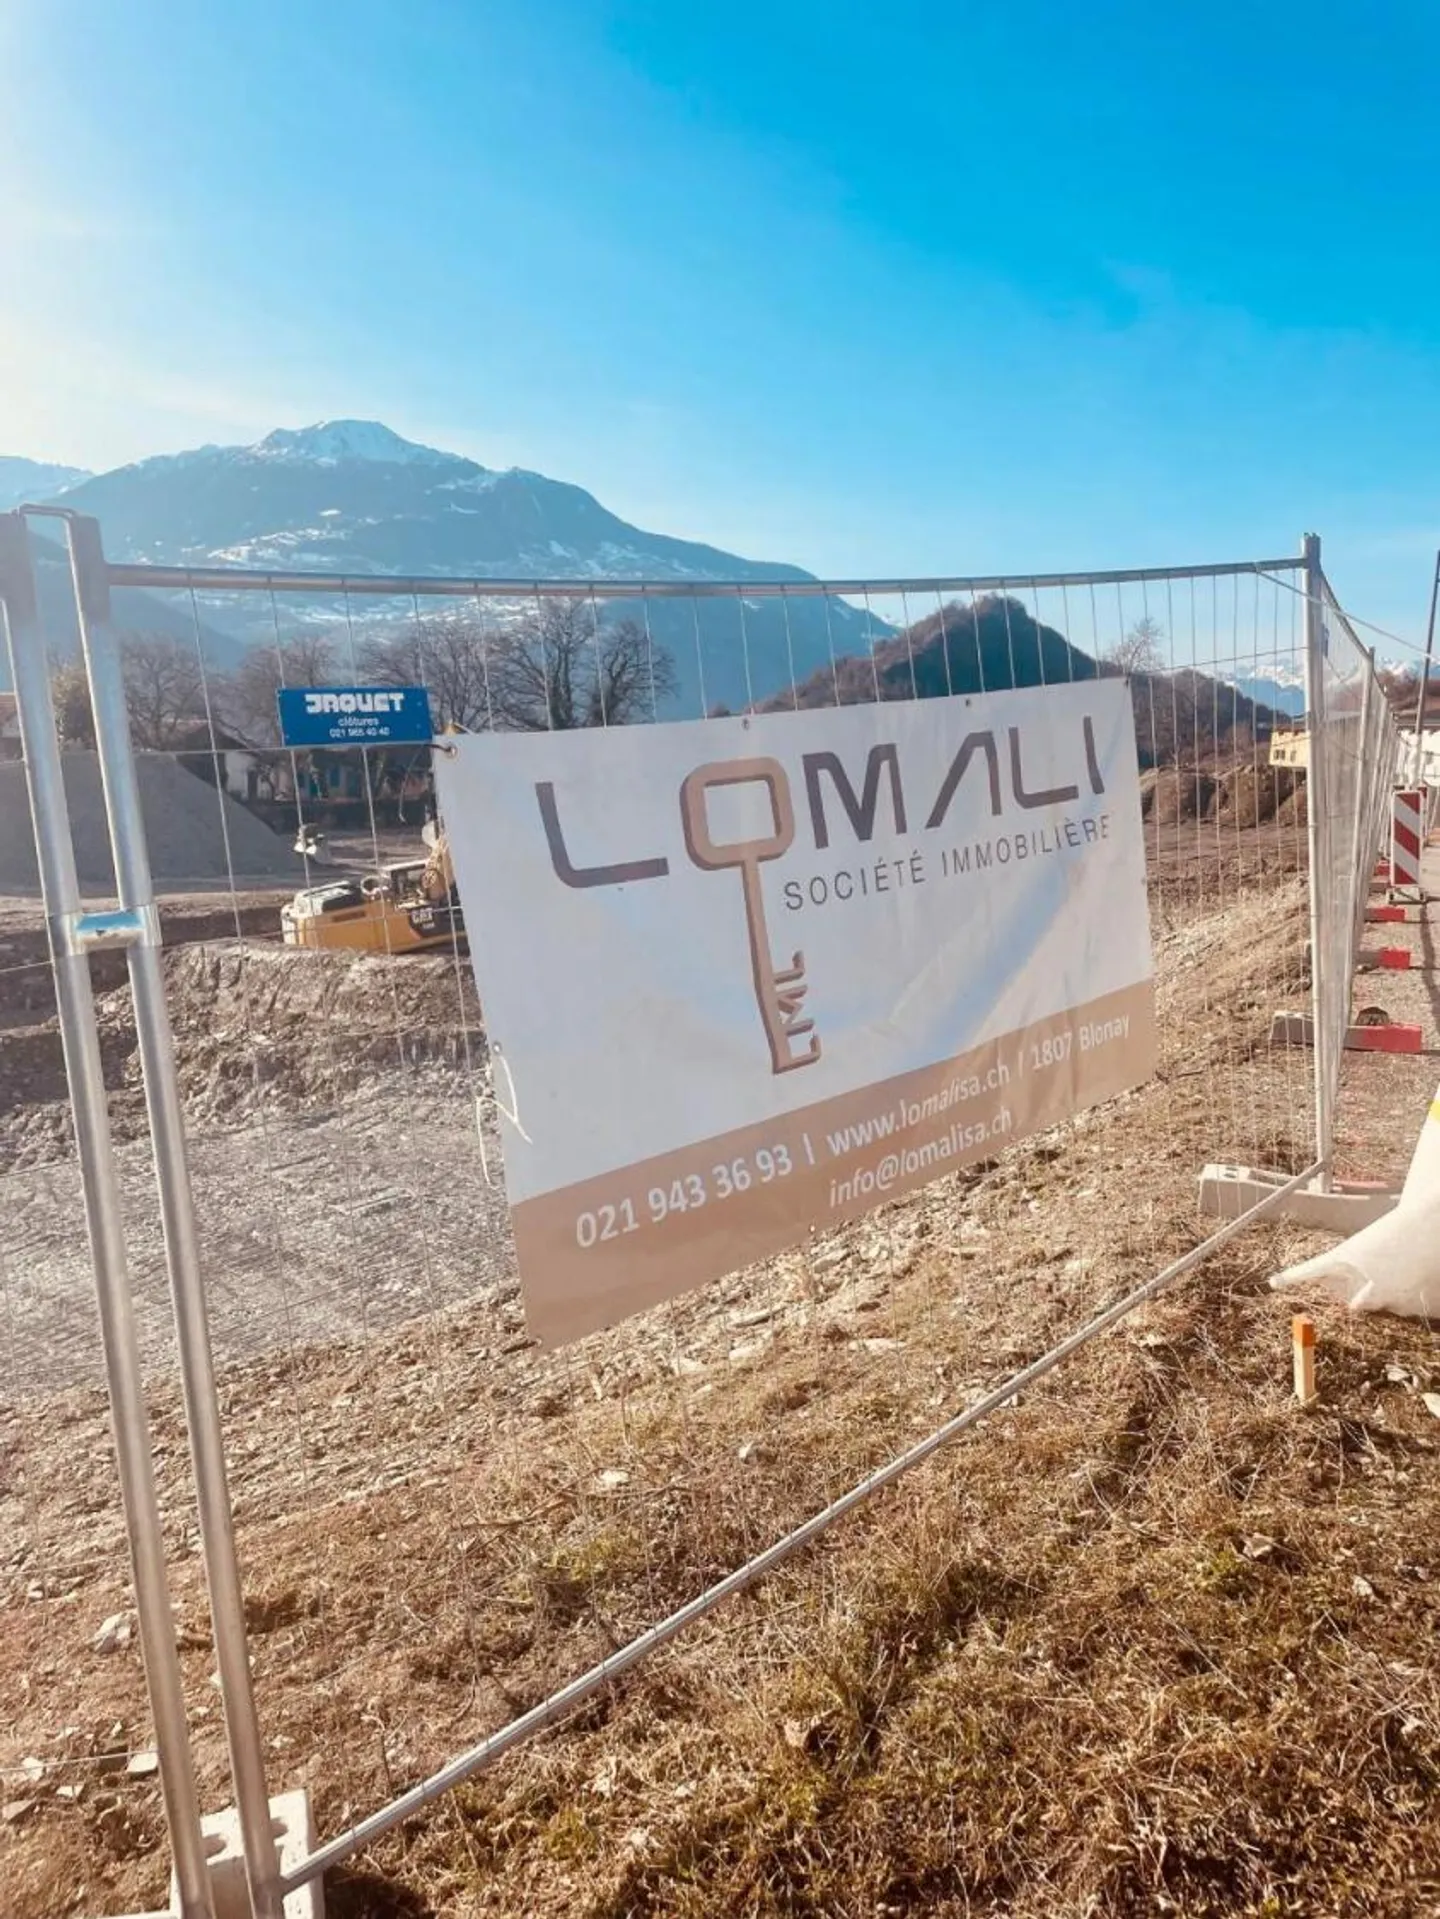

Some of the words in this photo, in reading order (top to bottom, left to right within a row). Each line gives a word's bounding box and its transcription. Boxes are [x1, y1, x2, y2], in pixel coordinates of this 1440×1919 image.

[304, 692, 404, 714] JAQUET
[535, 716, 1105, 888] LOMALI
[784, 850, 925, 911] SOCIÉTÉ
[941, 814, 1110, 878] IMMOBILIÈRE
[576, 1197, 640, 1249] 021
[648, 1174, 706, 1223] 943
[712, 1157, 751, 1198] 36
[755, 1143, 793, 1183] 93
[826, 1062, 1010, 1157] www.lomalisa.ch
[1031, 1031, 1073, 1071] 1807
[1079, 1013, 1130, 1052] Blonay
[828, 1105, 1012, 1209] info@lomalisa.ch
